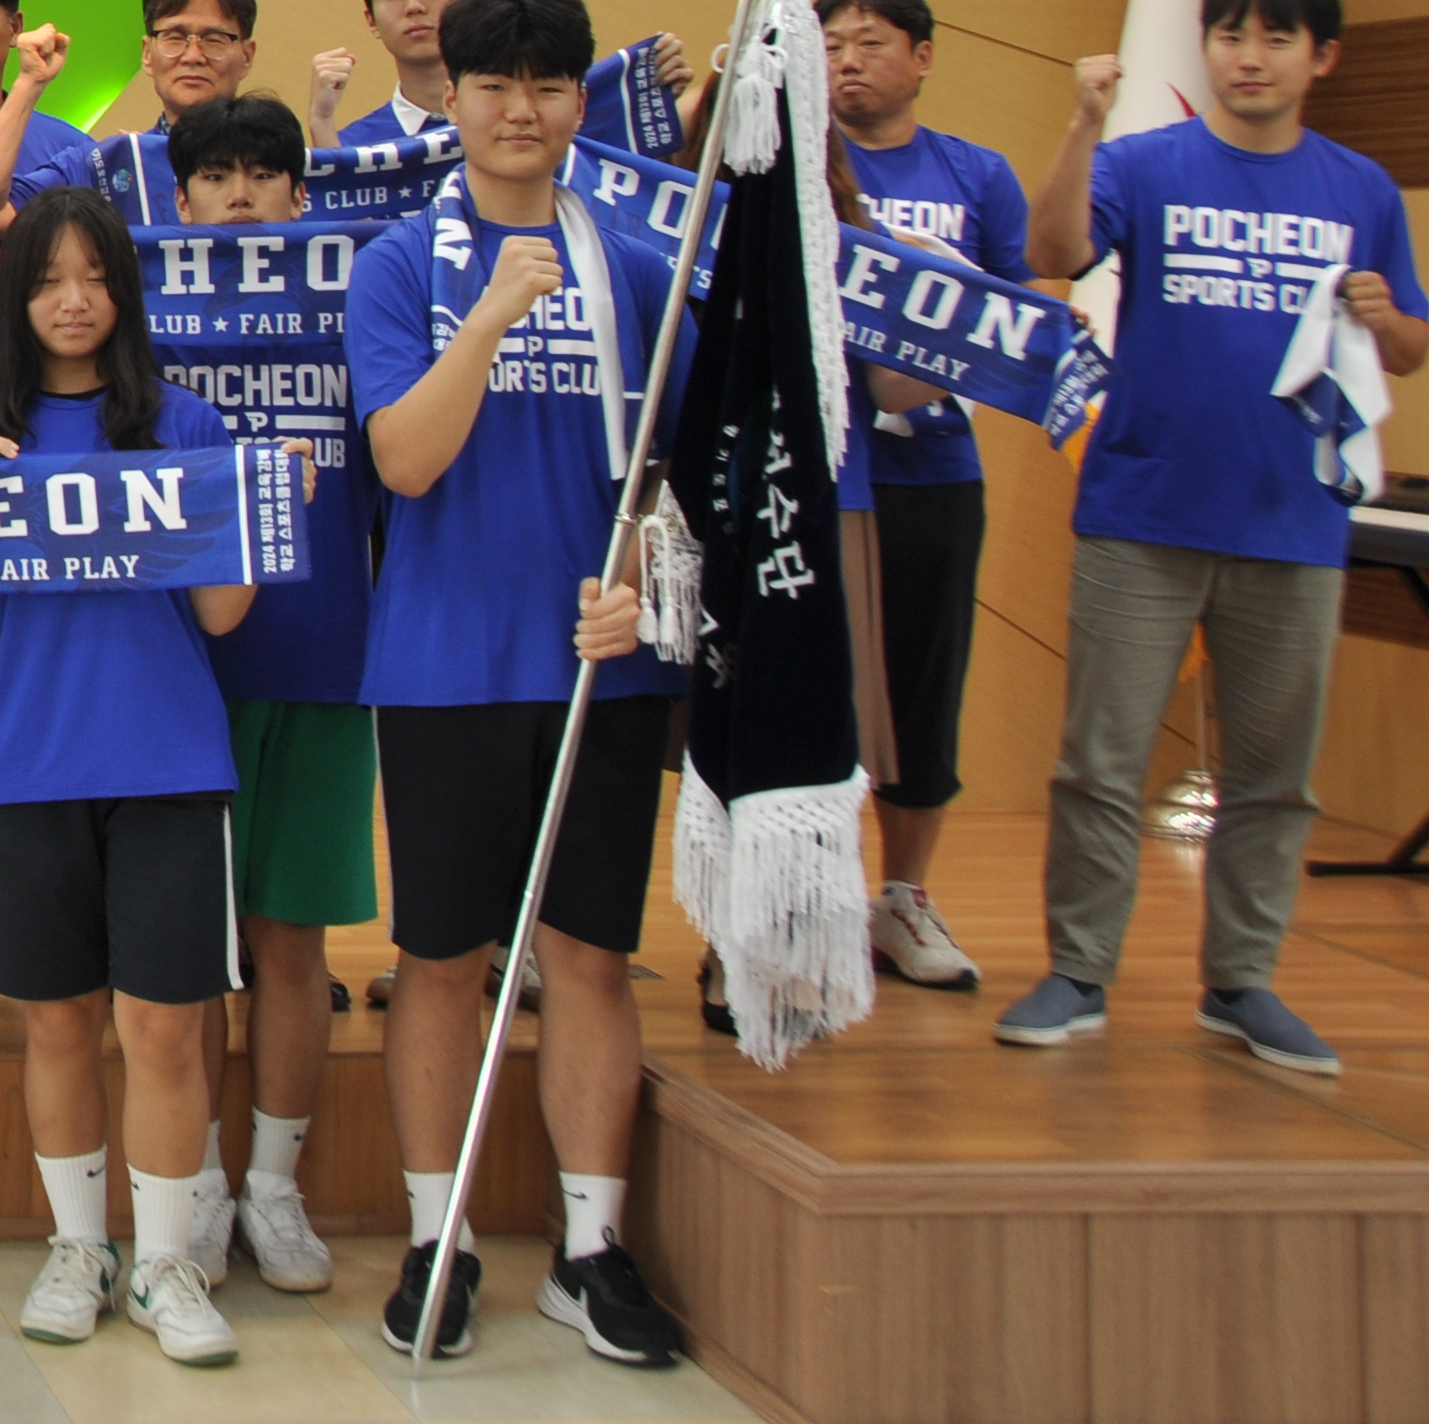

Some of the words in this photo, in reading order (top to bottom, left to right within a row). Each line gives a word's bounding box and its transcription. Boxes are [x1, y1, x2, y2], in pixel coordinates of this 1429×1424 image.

[642, 125, 660, 150] 2024
[324, 182, 389, 209] CLUB
[1163, 202, 1353, 269] POCHEON
[1162, 275, 1276, 316] SPORTS
[149, 313, 202, 336] LUB
[239, 312, 304, 336] FAIR
[840, 320, 894, 361] AIR
[895, 338, 970, 383] PLAY
[551, 362, 604, 397] CLU
[255, 448, 273, 500] 교육감배
[258, 502, 276, 543] 제13회
[64, 554, 140, 581] PLAY
[261, 544, 278, 574] 2024
[279, 543, 295, 572] 학교
